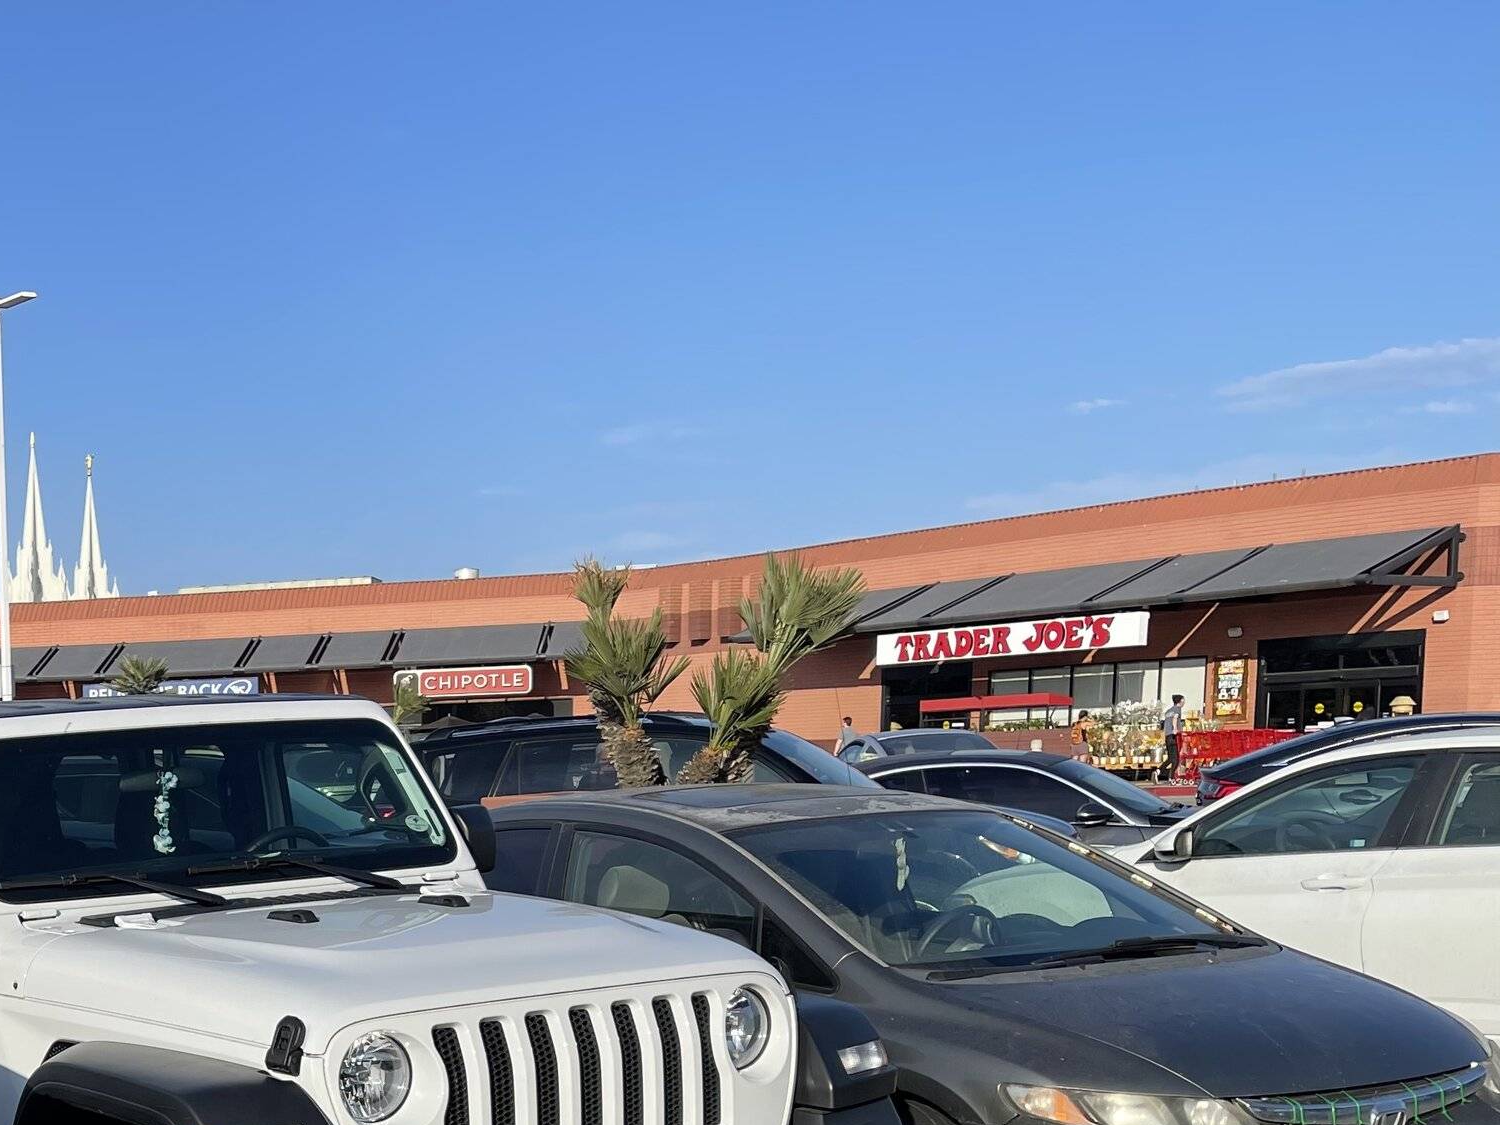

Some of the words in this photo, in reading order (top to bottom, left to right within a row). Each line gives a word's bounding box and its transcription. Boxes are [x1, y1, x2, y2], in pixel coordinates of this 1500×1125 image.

[894, 626, 1012, 662] TRADER
[1023, 615, 1115, 651] JOE'S
[177, 683, 222, 695] BACK
[424, 673, 525, 690] CHIPOTLE
